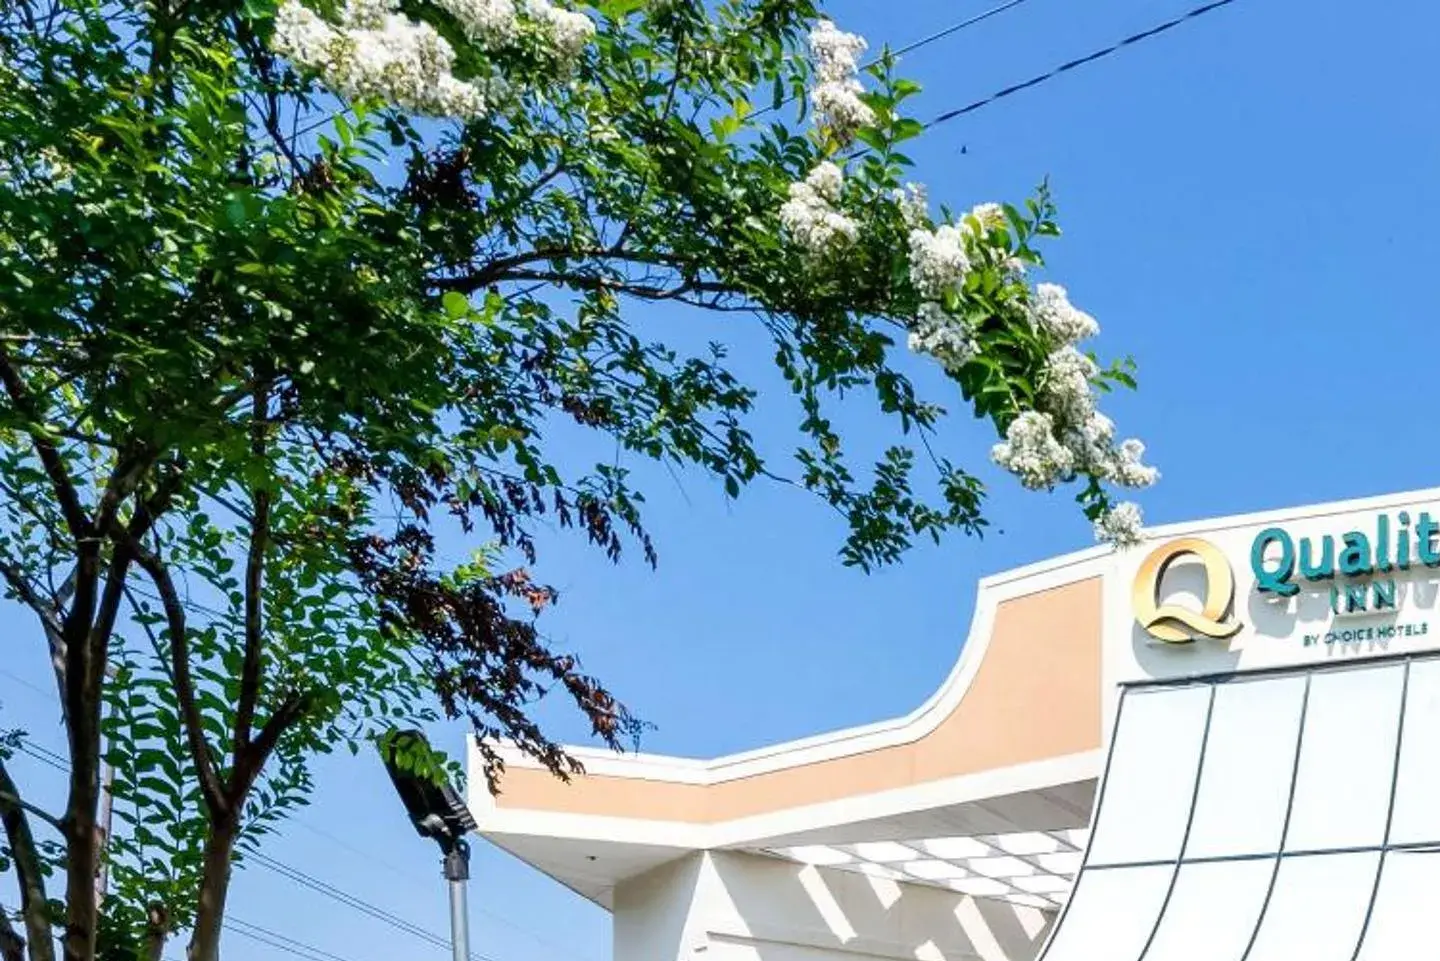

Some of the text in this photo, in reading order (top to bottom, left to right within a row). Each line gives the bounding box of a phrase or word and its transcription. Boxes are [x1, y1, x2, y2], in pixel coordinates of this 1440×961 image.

[1131, 537, 1244, 644] Q
[1329, 579, 1397, 615] INN
[1303, 622, 1428, 647] BY CHOICE HOTELS
